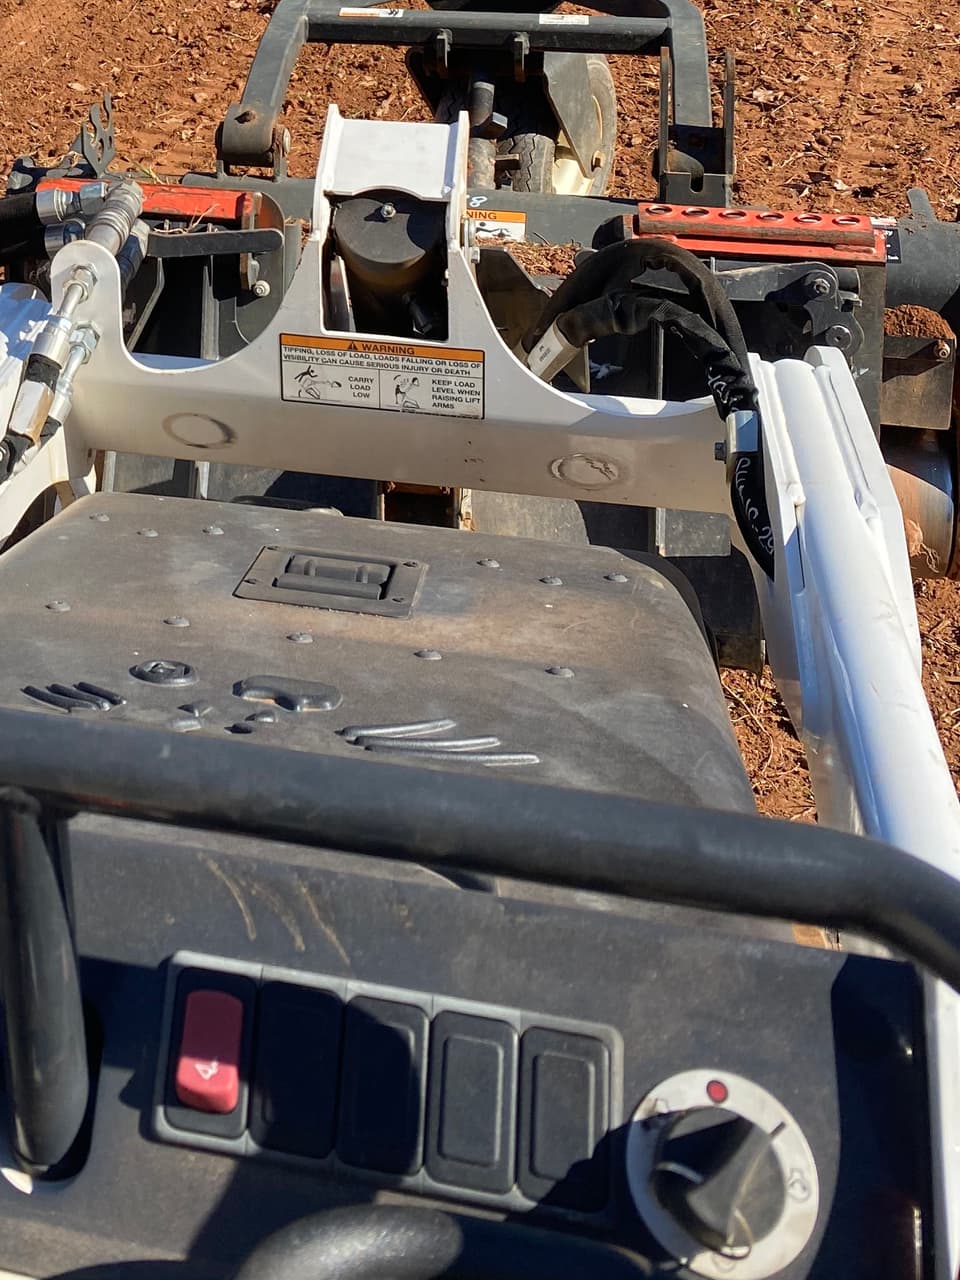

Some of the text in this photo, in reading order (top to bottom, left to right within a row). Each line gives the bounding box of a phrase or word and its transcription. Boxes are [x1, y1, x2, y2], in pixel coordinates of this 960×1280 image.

[283, 346, 315, 355] TIPPING,
[315, 349, 336, 357] LOSS
[349, 352, 372, 360] LOAD,
[374, 354, 399, 362] LOADS
[401, 357, 433, 365] FALLING
[361, 343, 415, 355] WARNING
[283, 354, 320, 363] VISIBILITY
[339, 359, 364, 367] CAUSE
[366, 361, 399, 369] SERIOUS
[401, 364, 429, 372] INJURY
[431, 394, 463, 402] RAISING
